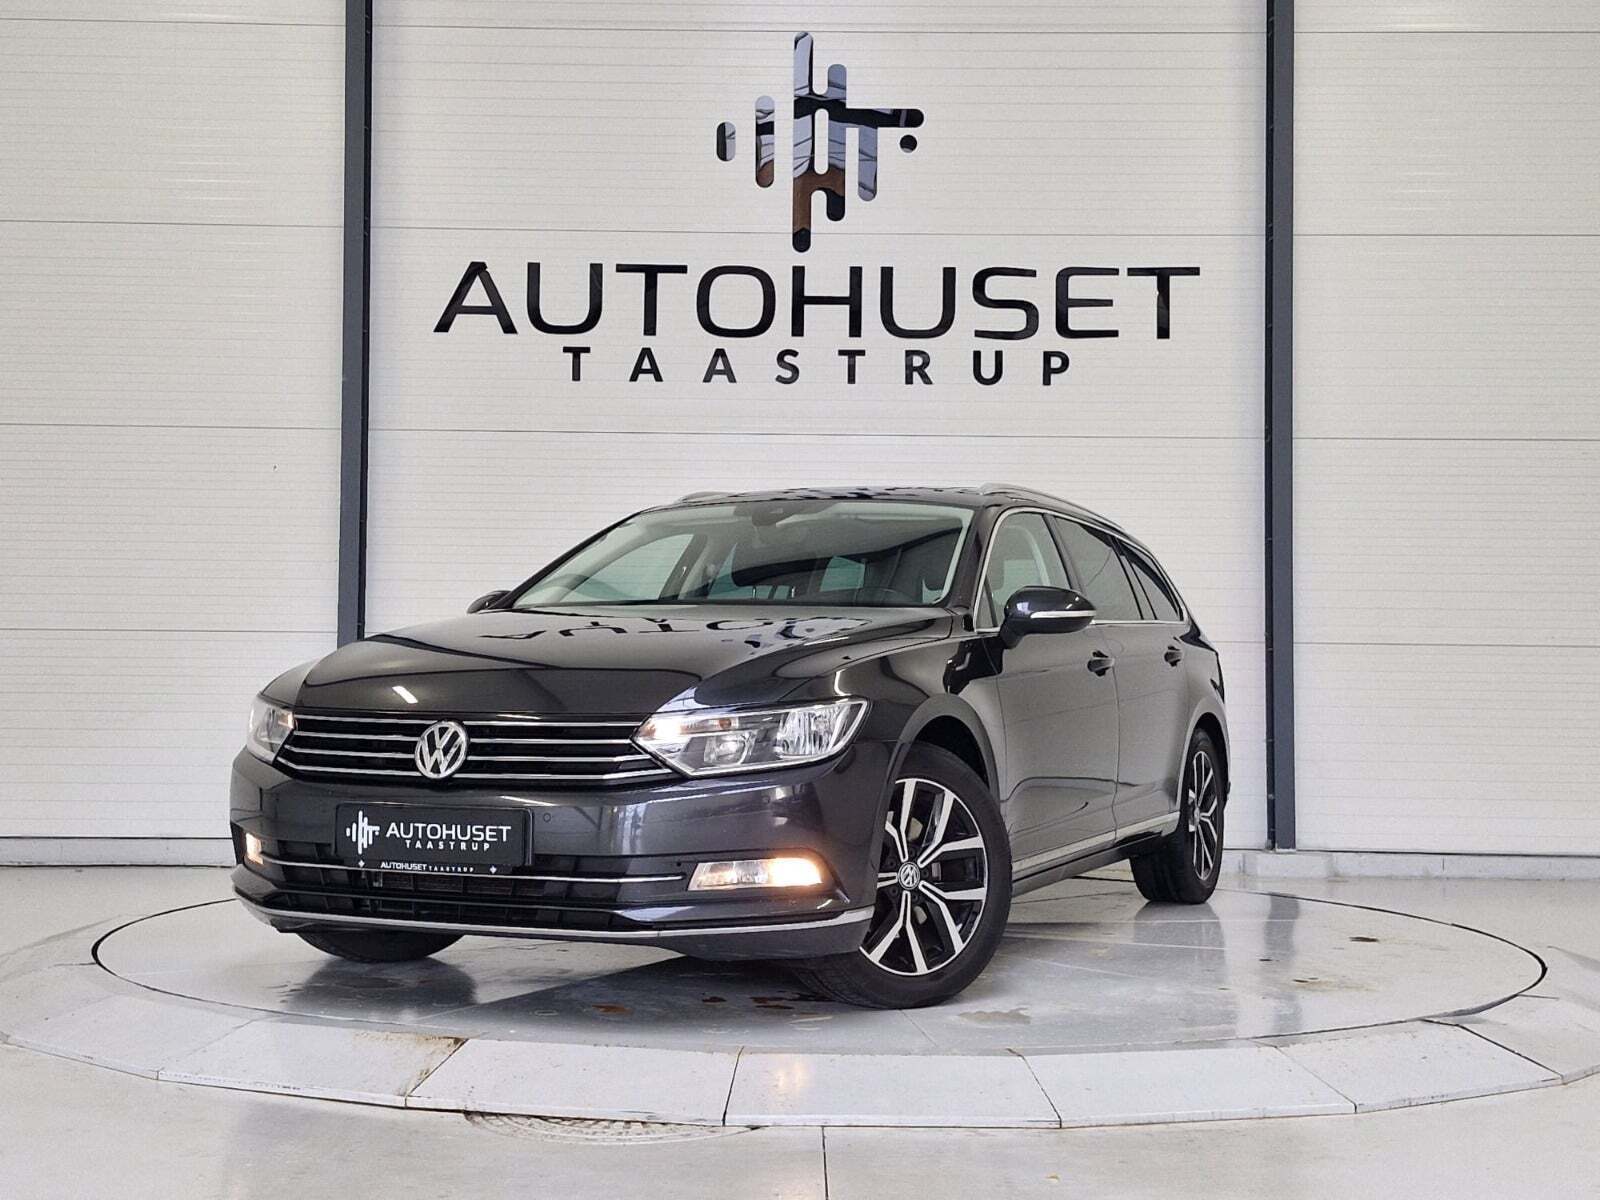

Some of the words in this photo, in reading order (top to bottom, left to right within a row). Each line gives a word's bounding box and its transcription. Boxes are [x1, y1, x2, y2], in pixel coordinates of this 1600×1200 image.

[433, 261, 1200, 340] AUTOHUSET
[562, 346, 1071, 386] TAASTRUP
[386, 822, 511, 842] AUTOHUSET
[405, 839, 490, 851] TAASTRUP
[380, 861, 427, 871] AUTOHUSET
[429, 865, 474, 873] TAASTRUP
